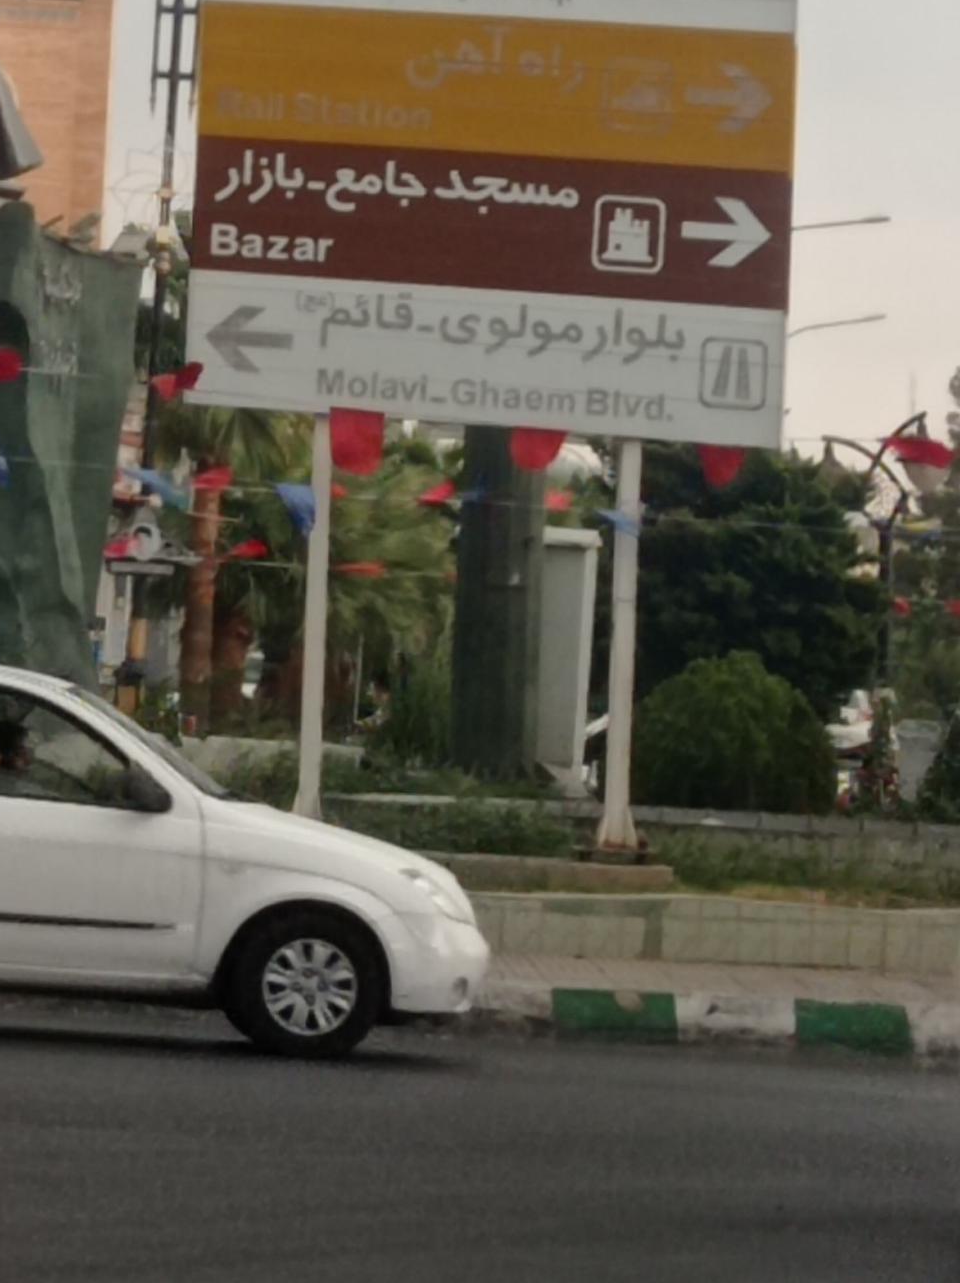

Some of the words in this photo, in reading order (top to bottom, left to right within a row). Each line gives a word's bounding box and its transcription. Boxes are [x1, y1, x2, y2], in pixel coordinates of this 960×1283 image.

[433, 169, 581, 215] مسجد
[209, 222, 335, 263] Bazar
[584, 388, 675, 424] Blvd.
